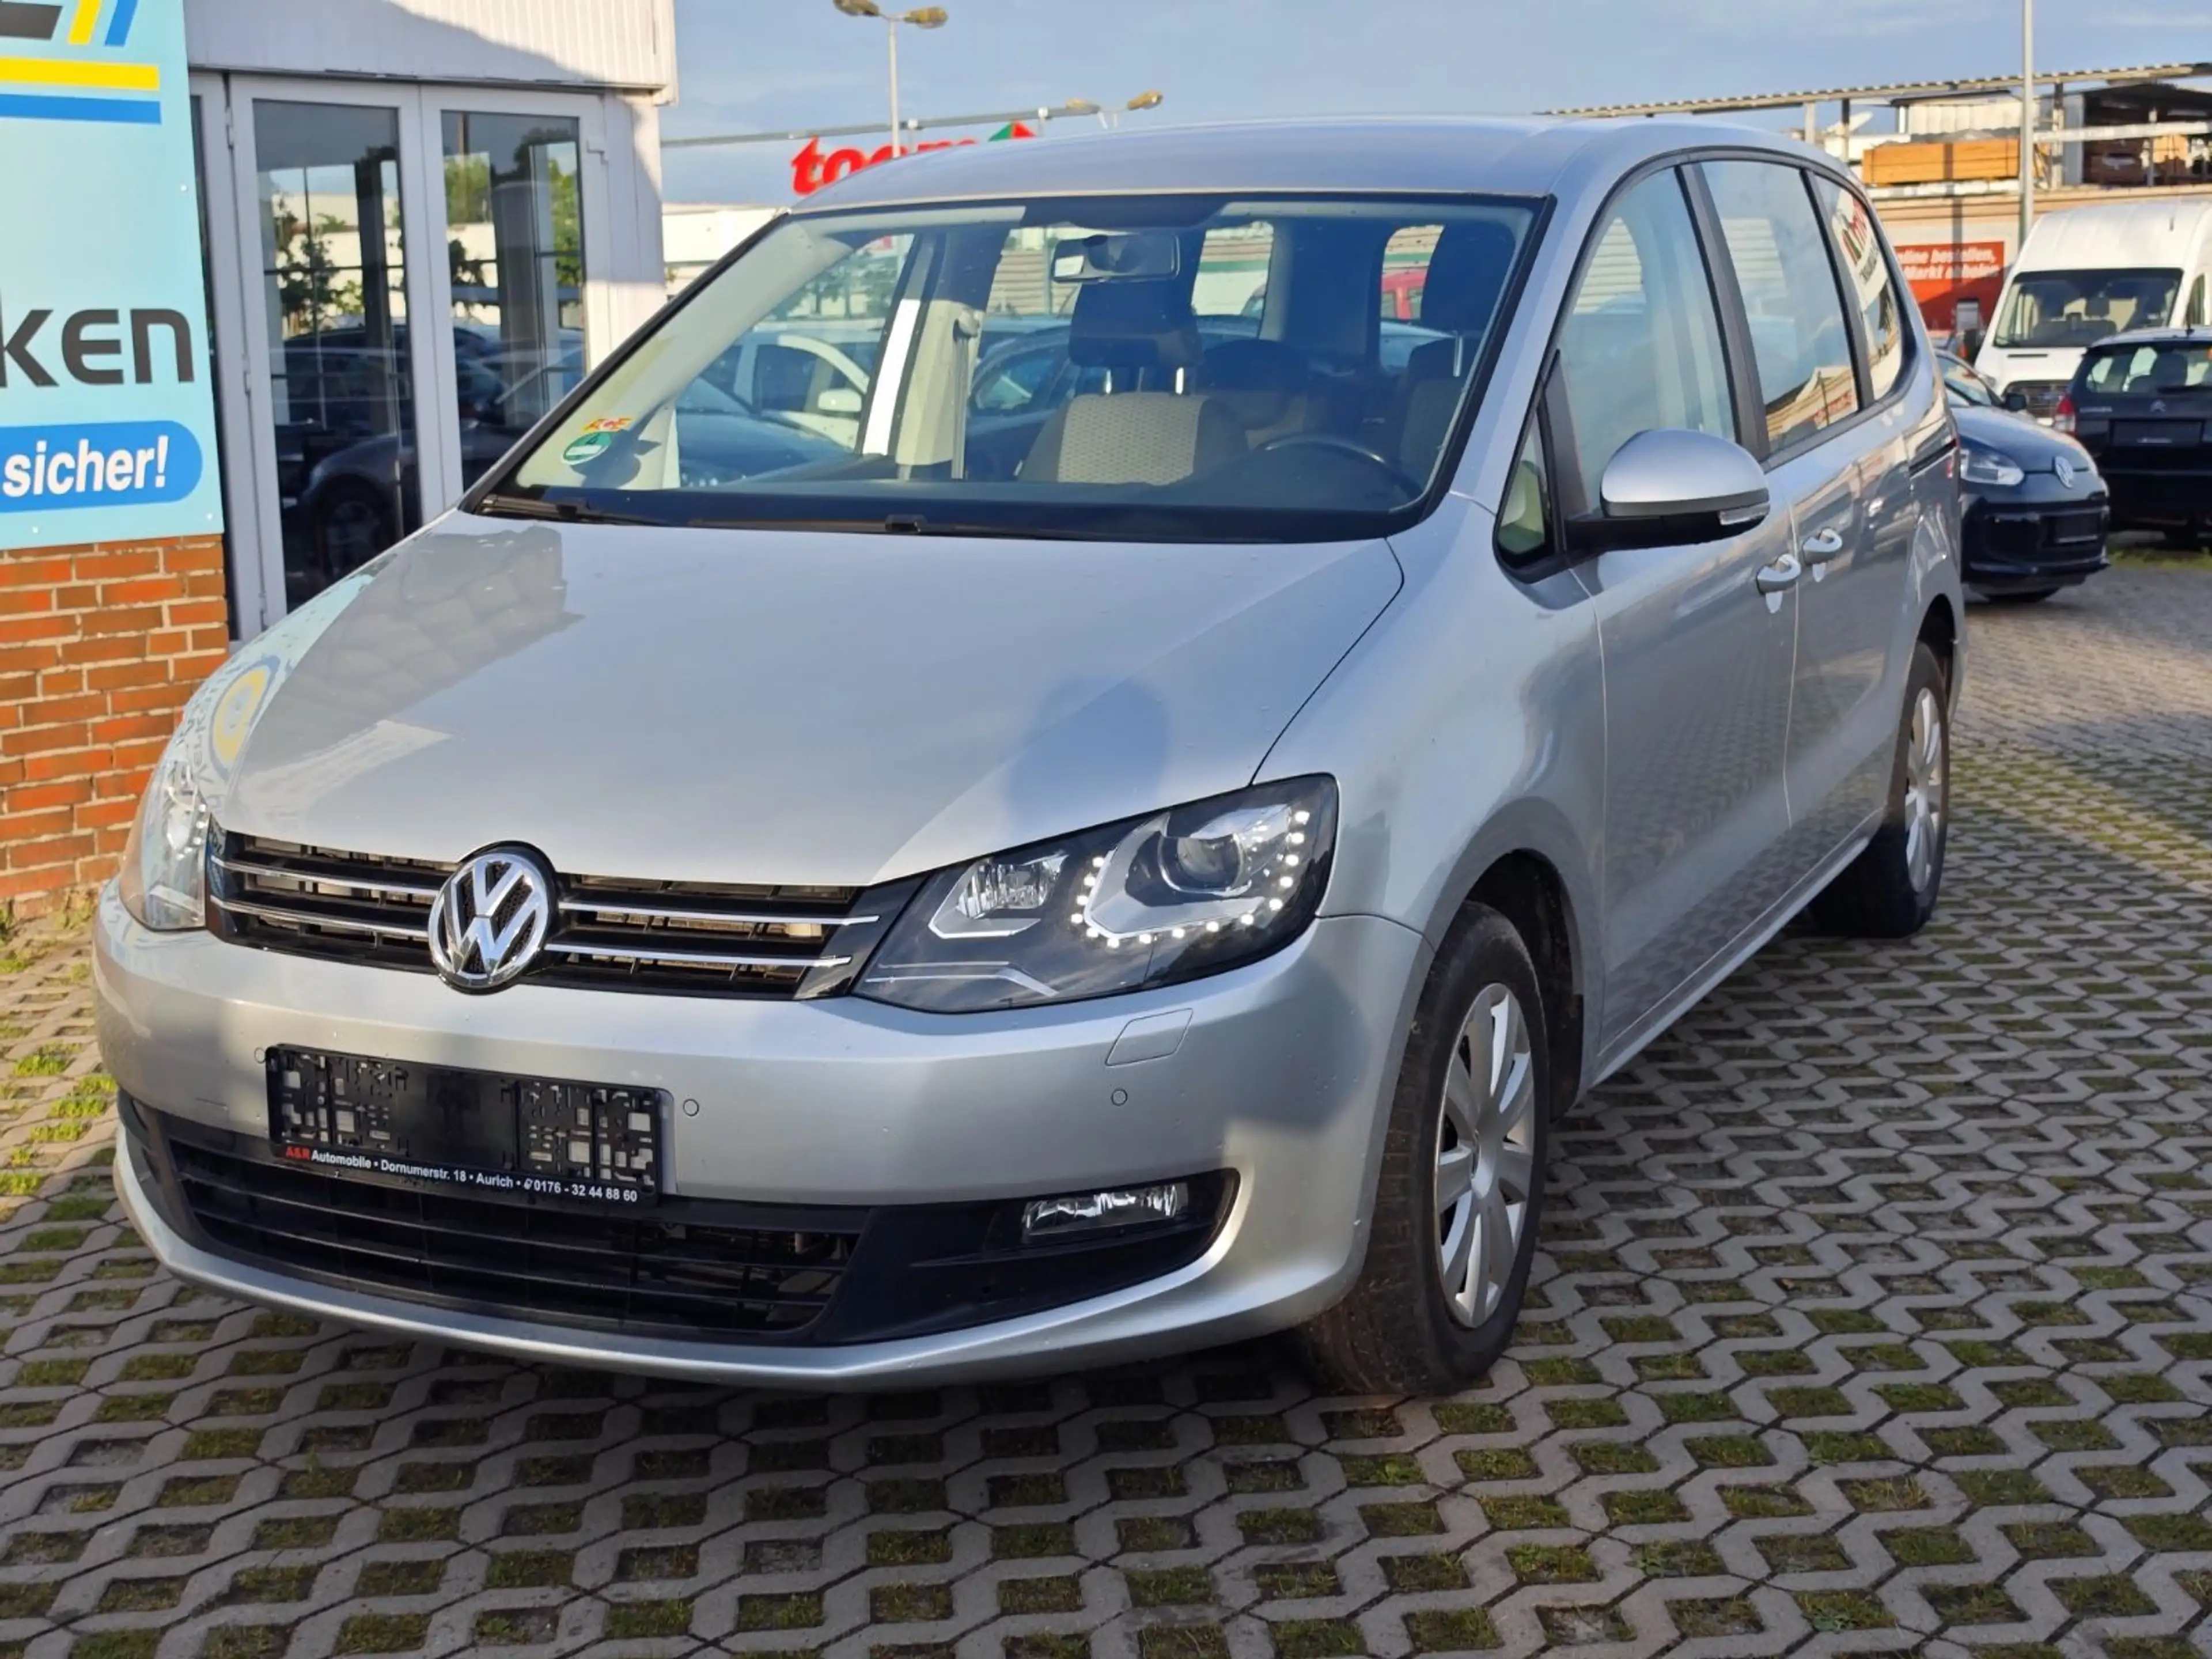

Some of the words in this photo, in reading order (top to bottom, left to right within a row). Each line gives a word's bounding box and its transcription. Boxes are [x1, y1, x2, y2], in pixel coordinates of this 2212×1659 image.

[3, 435, 169, 498] sicher!
[311, 1150, 372, 1169] Automobile
[381, 1159, 450, 1180] Dornumerstr.
[453, 1169, 467, 1181] 18
[476, 1173, 513, 1188] Aurich
[533, 1180, 561, 1194] 0176
[571, 1184, 586, 1196] 32
[589, 1185, 603, 1198] 44
[605, 1188, 620, 1200] 88
[623, 1190, 638, 1202] 60
